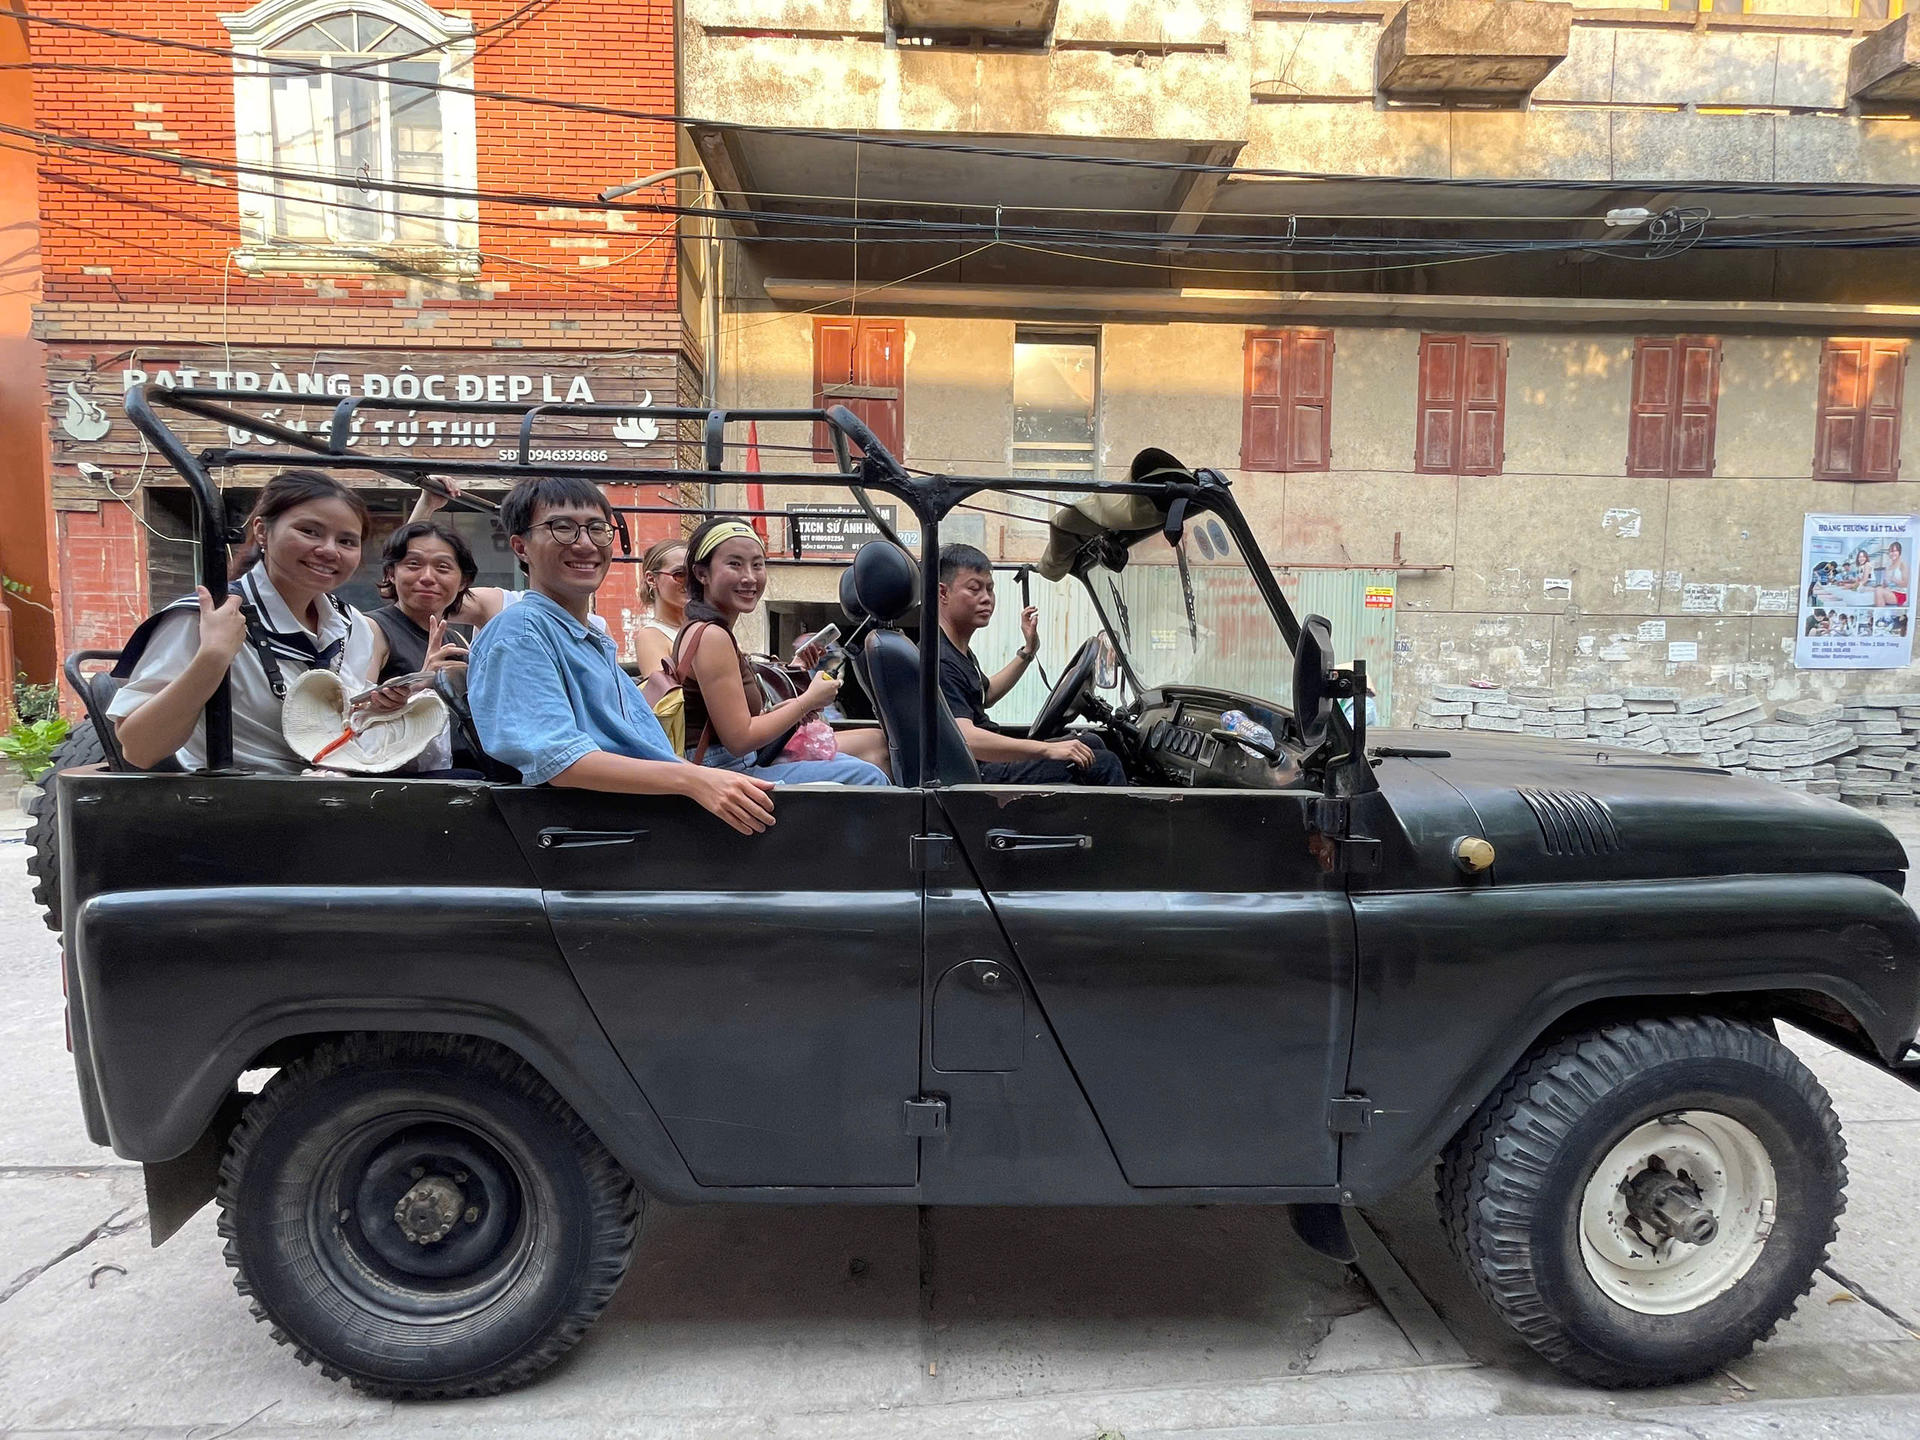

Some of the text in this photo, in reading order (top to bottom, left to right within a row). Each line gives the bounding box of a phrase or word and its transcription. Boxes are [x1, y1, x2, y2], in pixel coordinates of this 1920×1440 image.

[374, 409, 419, 447] TÚ
[426, 420, 496, 448] THU
[499, 449, 608, 462] SĐ 0946393686
